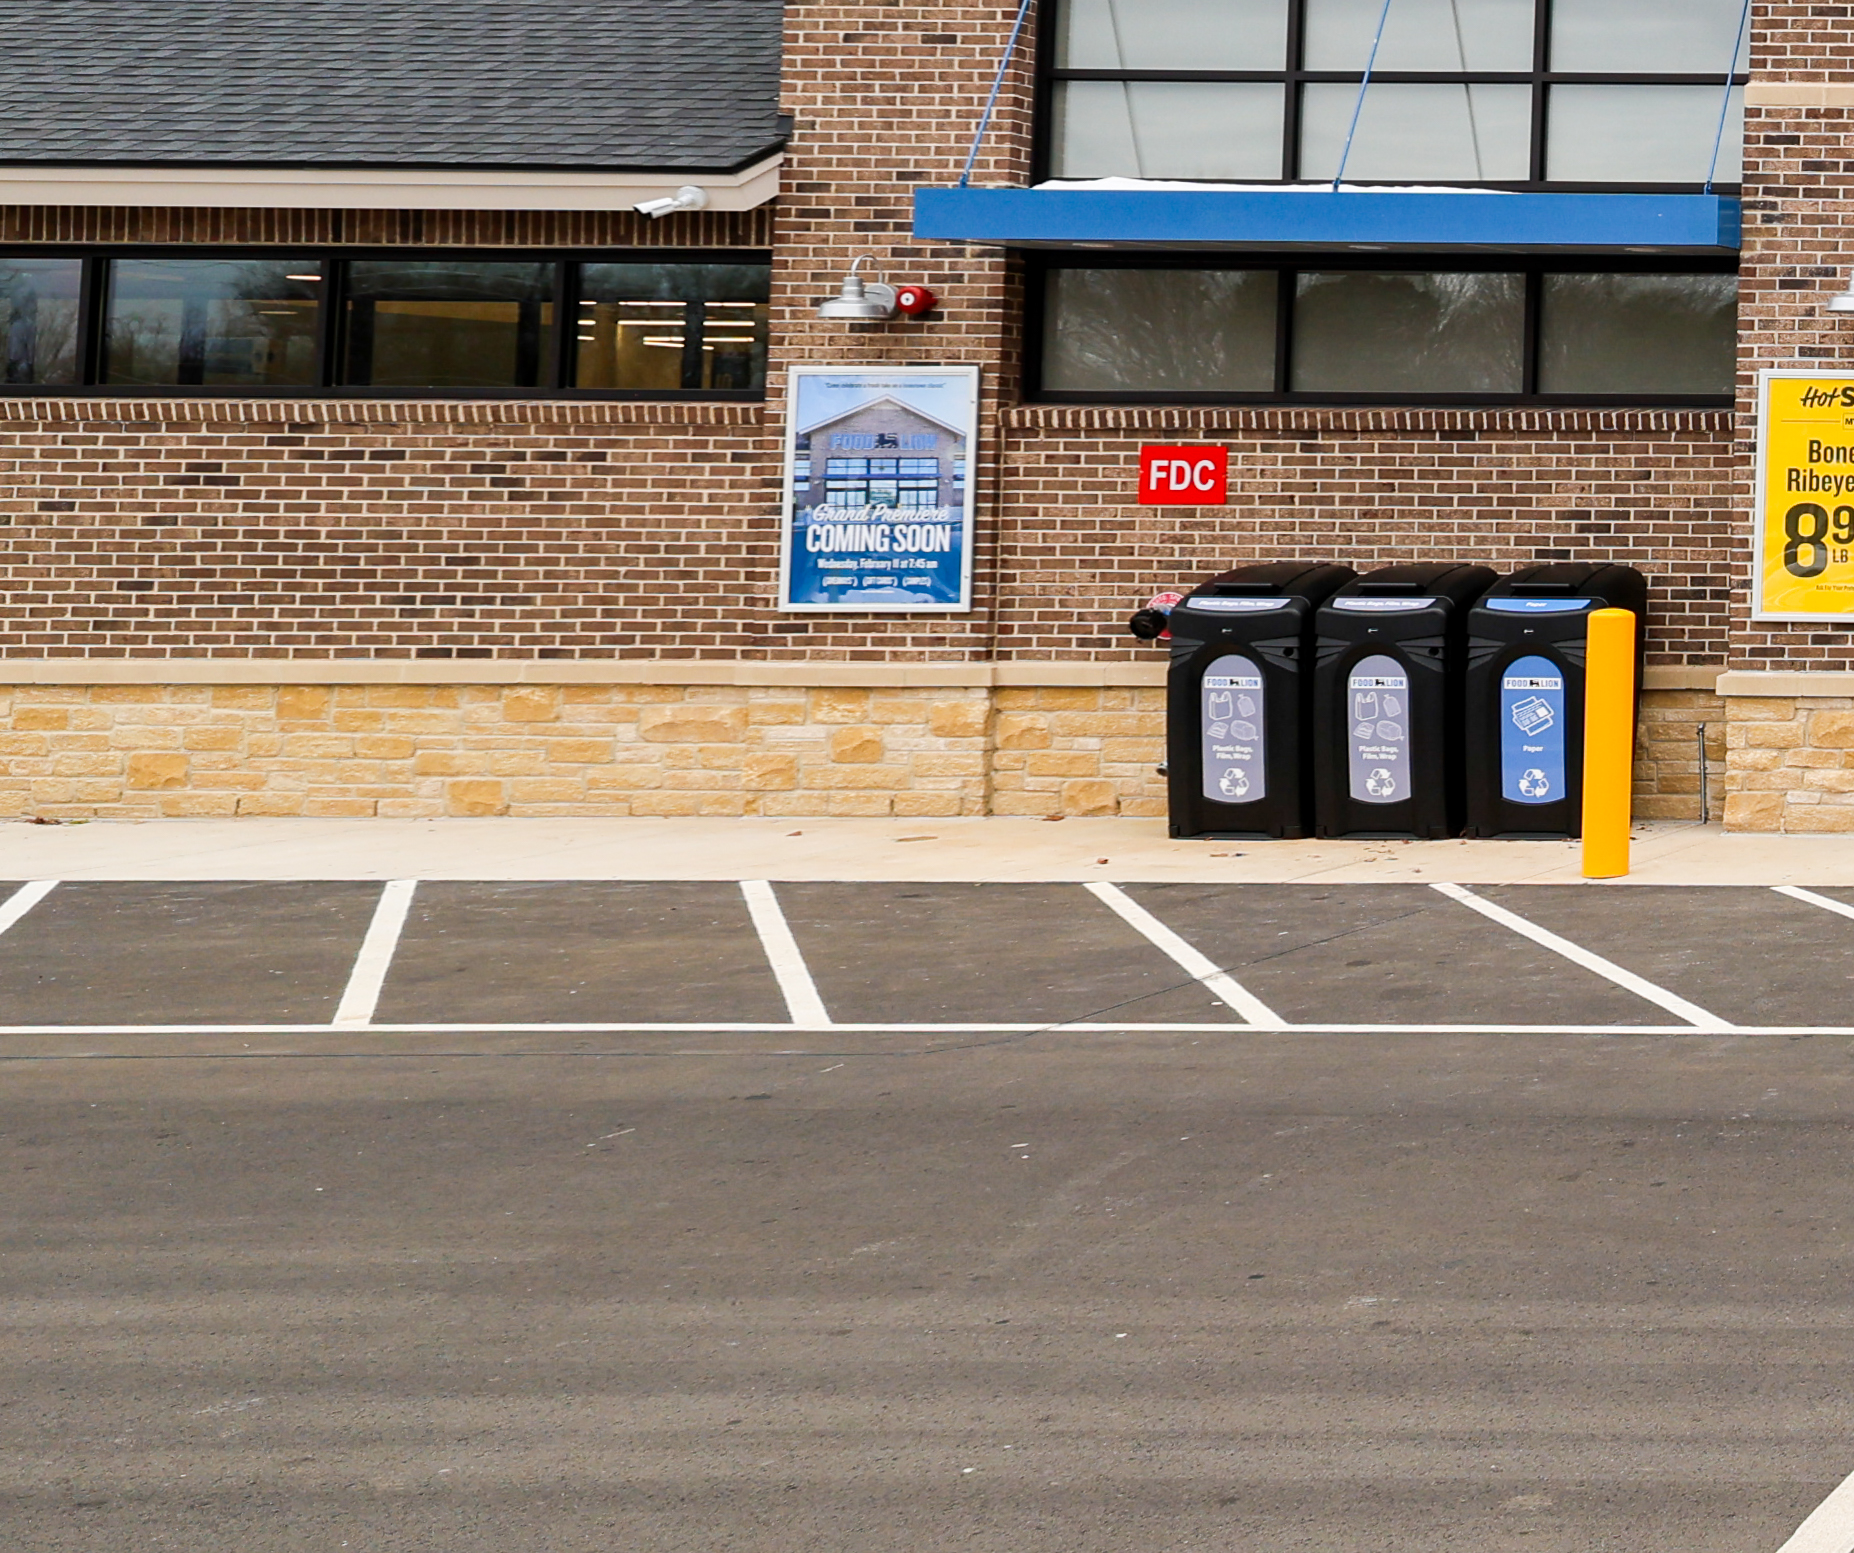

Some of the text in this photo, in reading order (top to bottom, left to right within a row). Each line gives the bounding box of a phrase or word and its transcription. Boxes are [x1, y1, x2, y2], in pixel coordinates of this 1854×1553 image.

[1800, 386, 1840, 408] Hot
[830, 433, 938, 450] FOOD LION
[1149, 459, 1216, 491] FDC
[813, 503, 949, 521] Grand Premiere
[806, 524, 950, 552] COMING SOON
[1833, 549, 1848, 563] LB
[860, 559, 891, 570] February
[900, 560, 908, 568] at
[909, 559, 926, 568] 7:45
[1207, 679, 1258, 687] FOOD LION
[1386, 679, 1404, 687] LION
[1523, 745, 1543, 753] Paper
